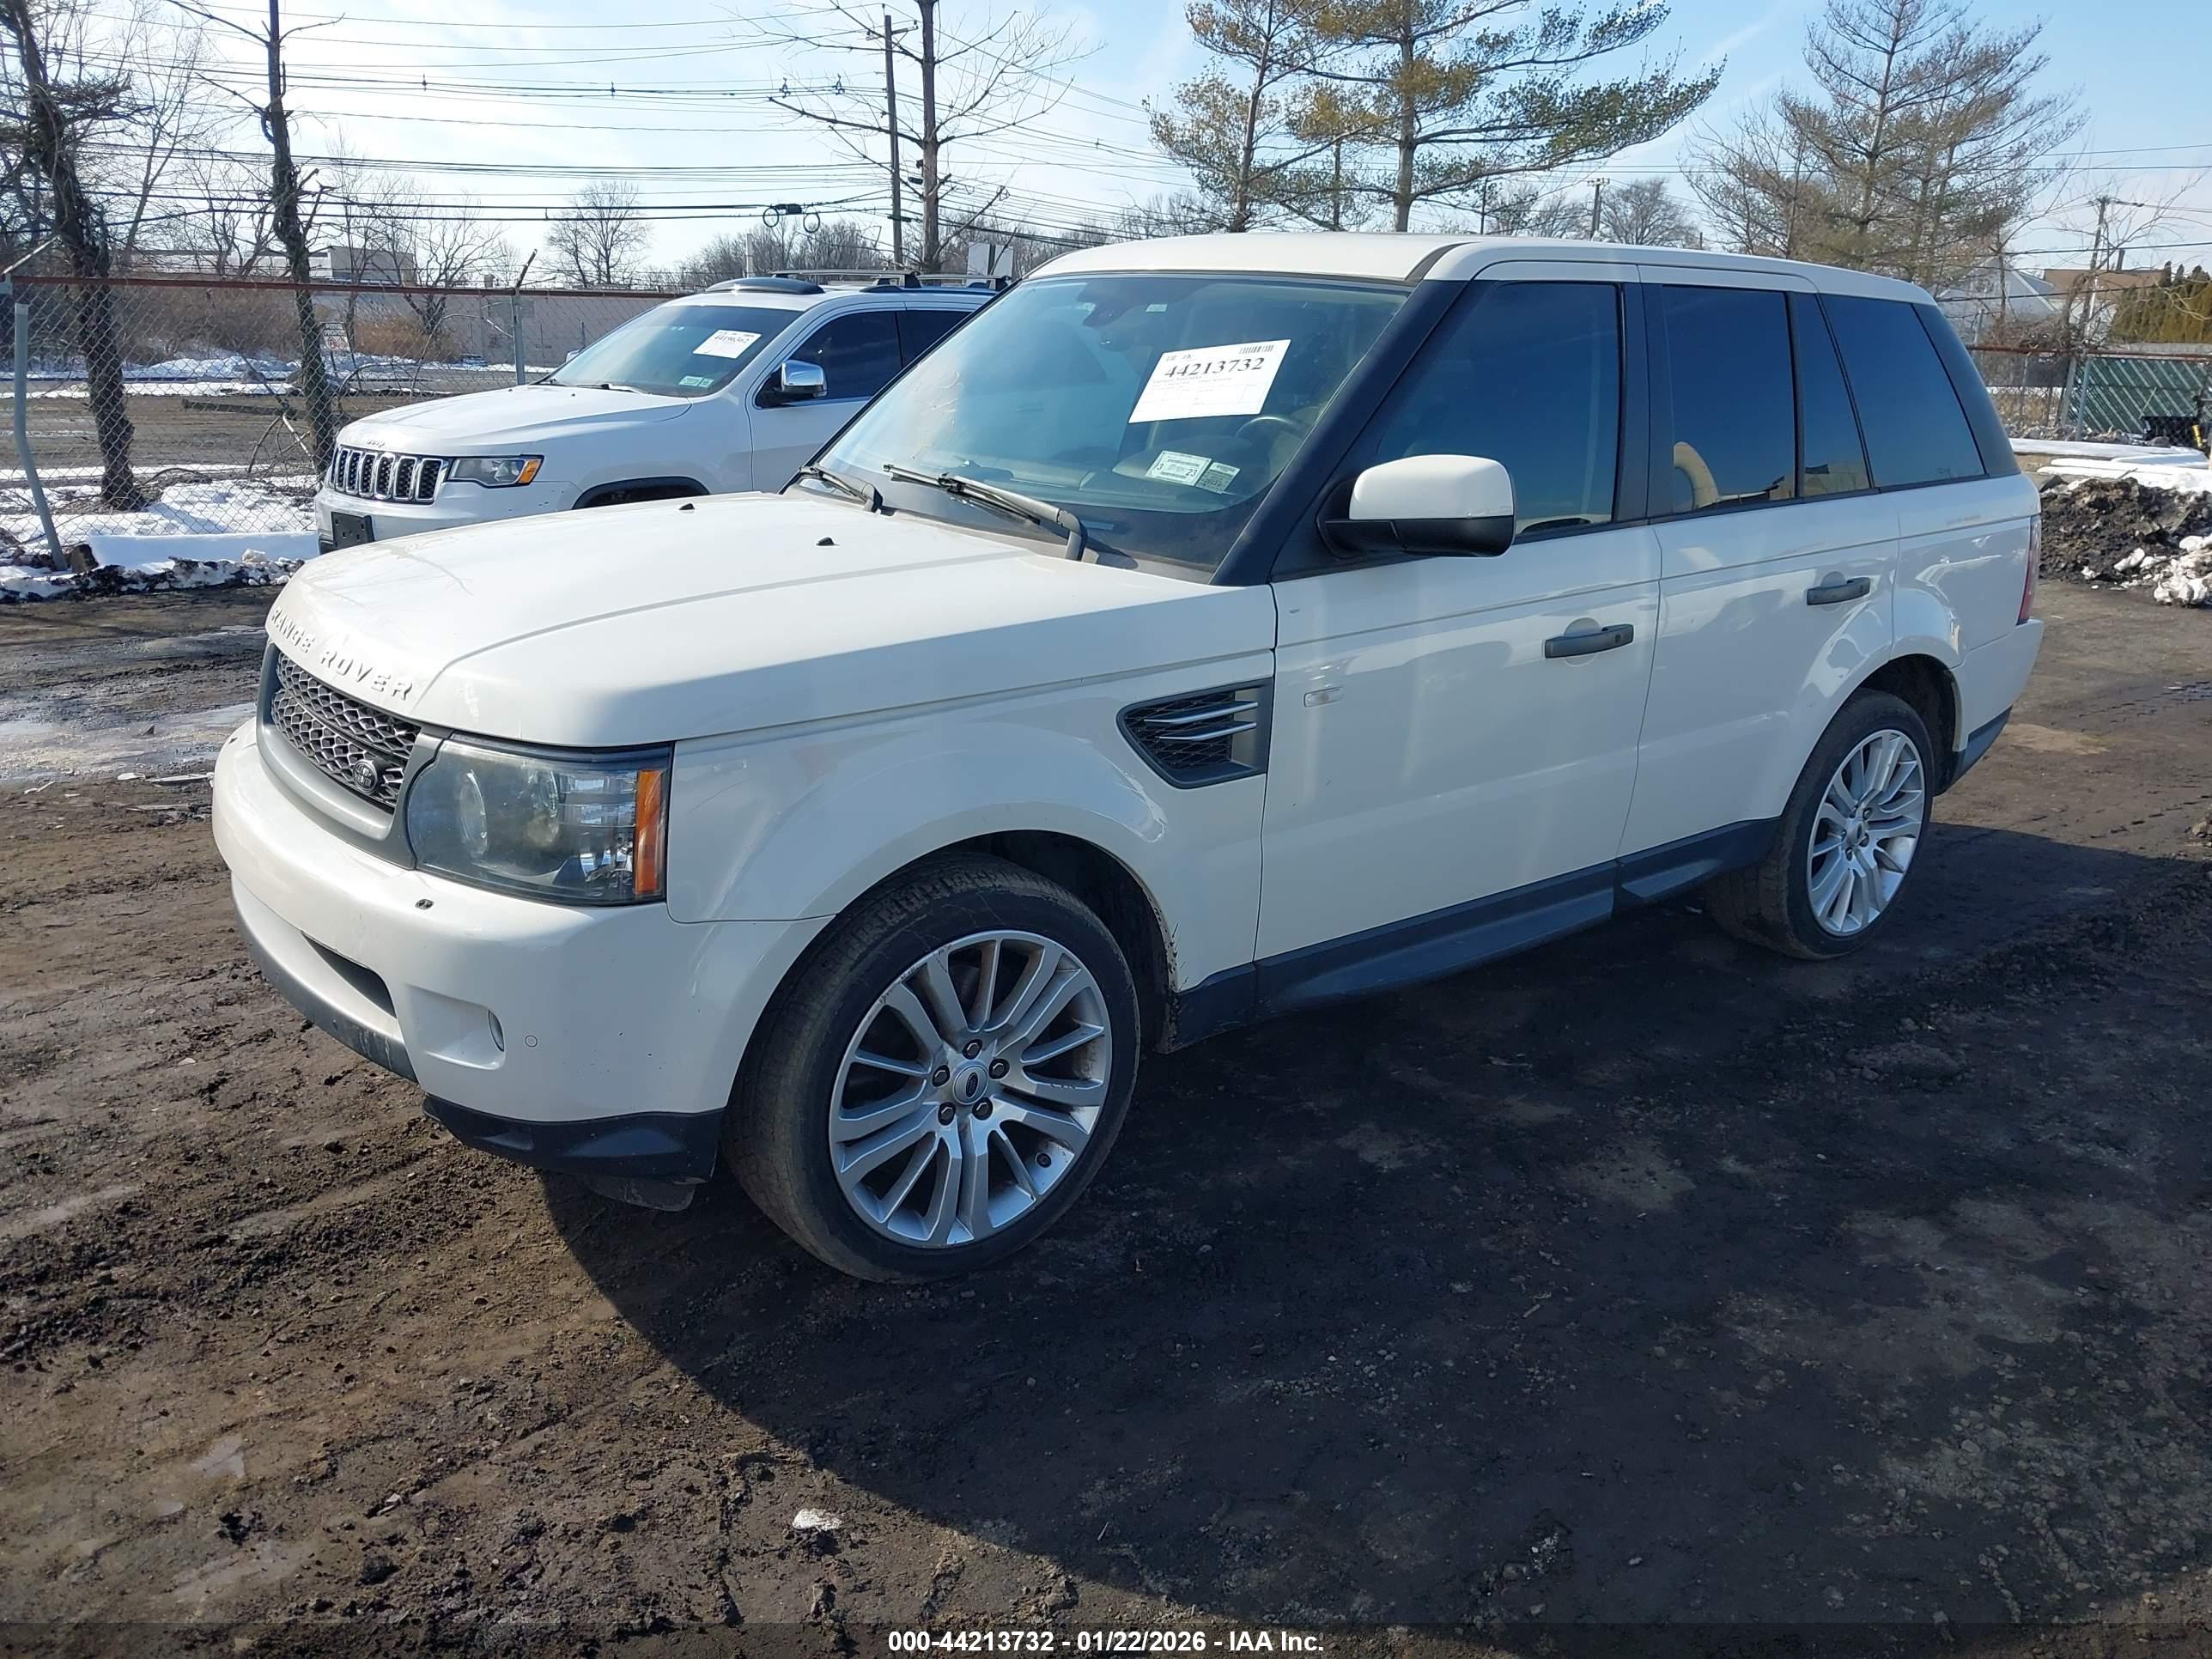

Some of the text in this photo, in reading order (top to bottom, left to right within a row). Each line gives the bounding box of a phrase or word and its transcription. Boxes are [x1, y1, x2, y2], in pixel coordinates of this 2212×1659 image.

[1164, 356, 1266, 378] 44213732
[1185, 468, 1198, 477] 23
[271, 608, 413, 701] RANGE ROVER
